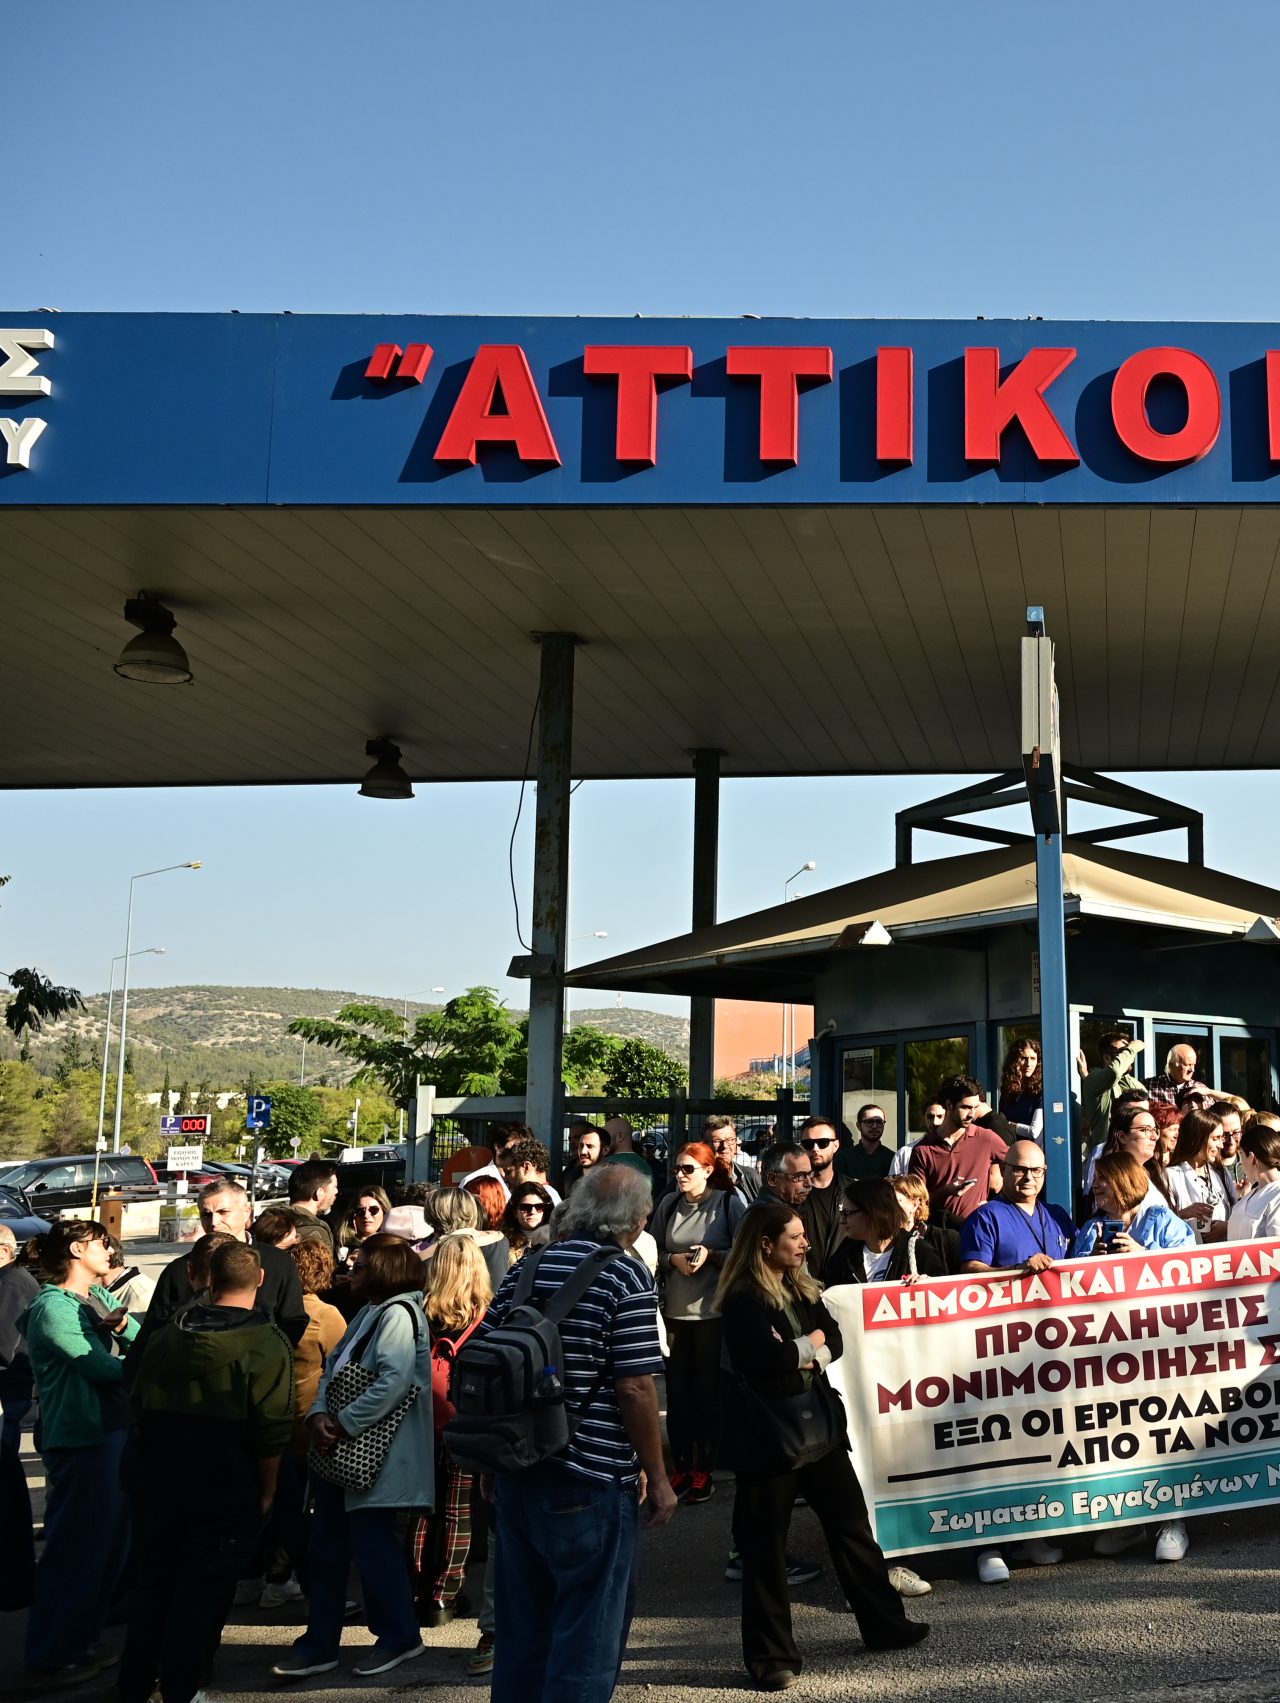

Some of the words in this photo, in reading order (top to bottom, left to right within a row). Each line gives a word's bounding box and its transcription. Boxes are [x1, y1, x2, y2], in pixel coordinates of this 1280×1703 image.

[167, 1117, 176, 1127] P
[182, 1119, 206, 1131] 000
[252, 1099, 266, 1119] P
[871, 1273, 1050, 1322] ΔΗΜΟΣΙΑ
[1060, 1265, 1126, 1298] ΚΑΙ
[975, 1295, 1269, 1359] ΠΡΟΣΛΗΨΕΙΣ
[877, 1341, 1246, 1414] ΜΟΝΙΜΟΠΟΙΗΣΗ
[934, 1414, 1011, 1450] ΕΞΩ
[1022, 1408, 1064, 1437] ΟΙ
[1057, 1432, 1139, 1468] ΑΠΟ
[1149, 1425, 1195, 1455] ΤΑ
[928, 1494, 1065, 1535] Σωματείο
[1072, 1472, 1260, 1520] Εργαζομένων
